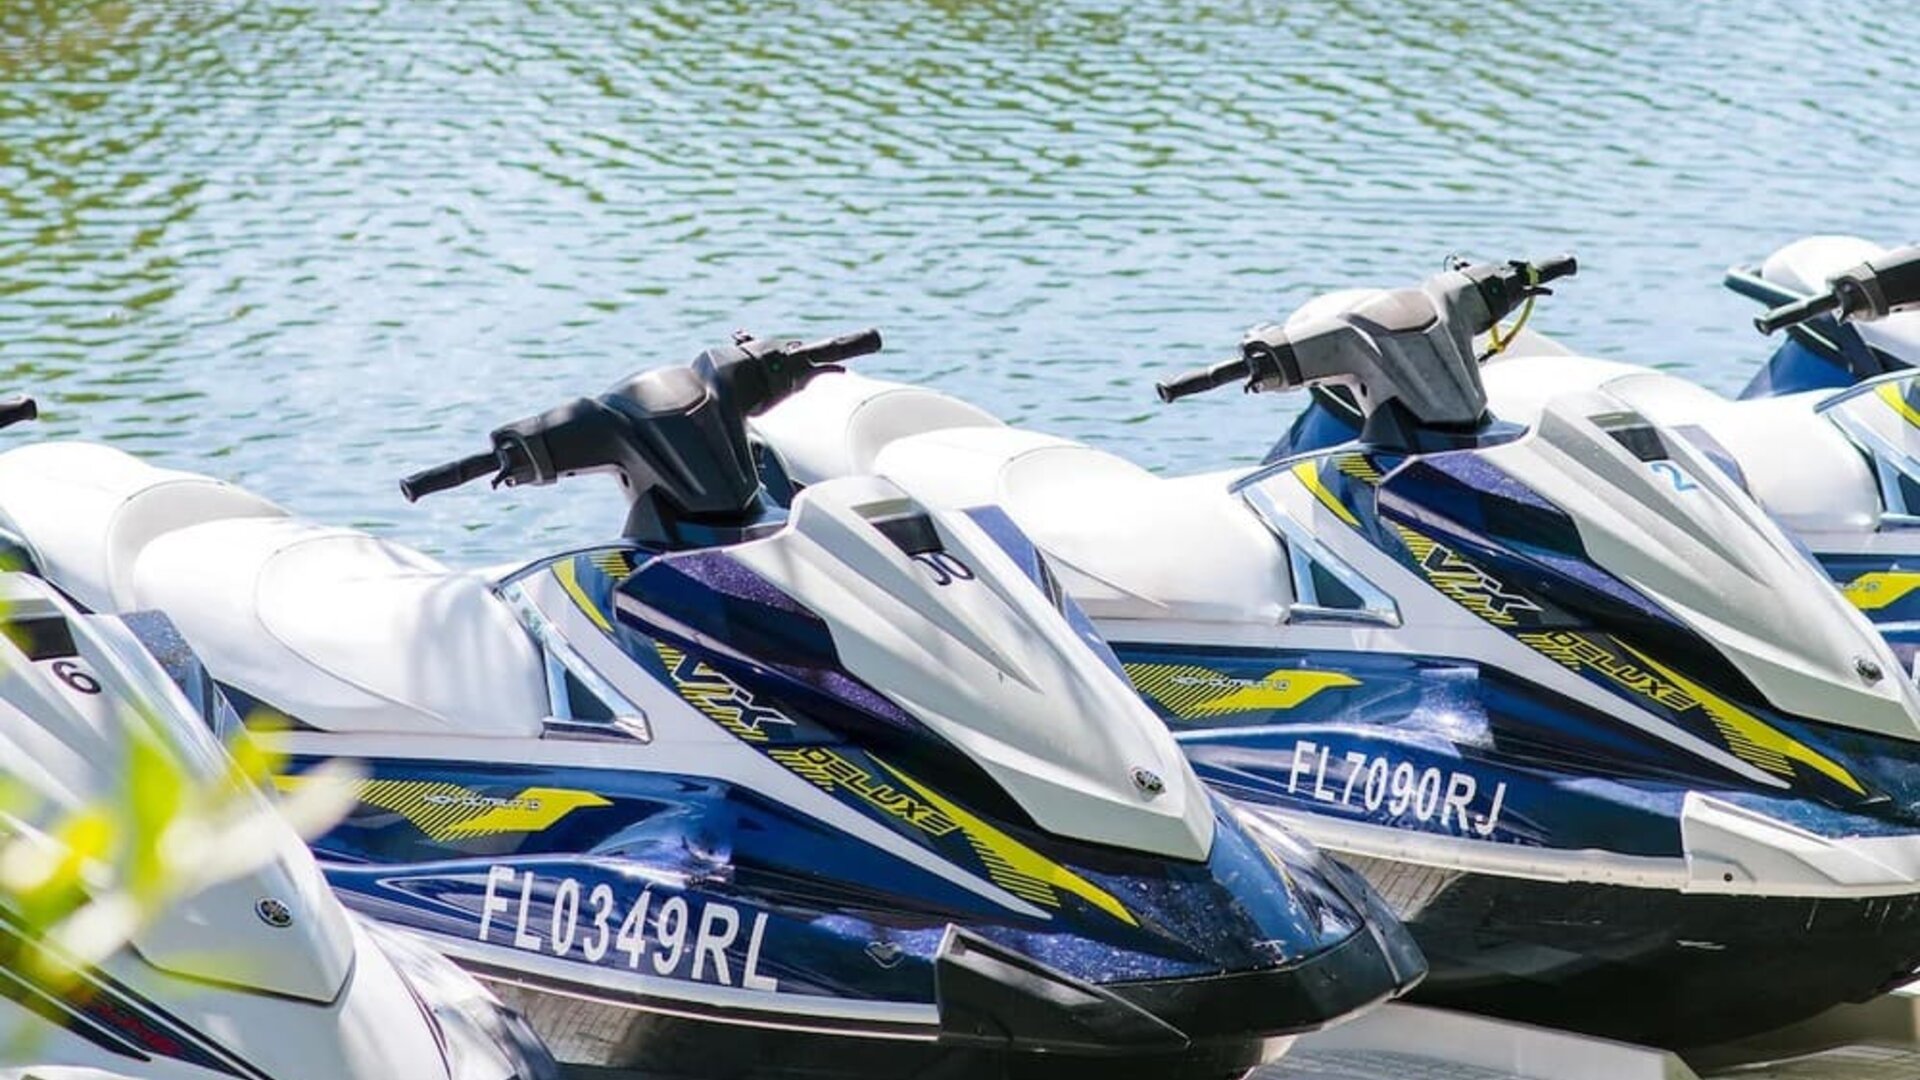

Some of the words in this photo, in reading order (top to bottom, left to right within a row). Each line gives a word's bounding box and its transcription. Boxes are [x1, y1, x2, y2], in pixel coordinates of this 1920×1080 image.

[1651, 463, 1698, 491] 2
[1421, 545, 1543, 617] VX
[52, 661, 101, 693] 6
[671, 655, 796, 729] VX
[1547, 631, 1701, 711] DELUXE
[803, 748, 958, 836] DELUXE
[1288, 740, 1506, 835] FL7090RJ
[479, 865, 779, 993] FL0349RL
